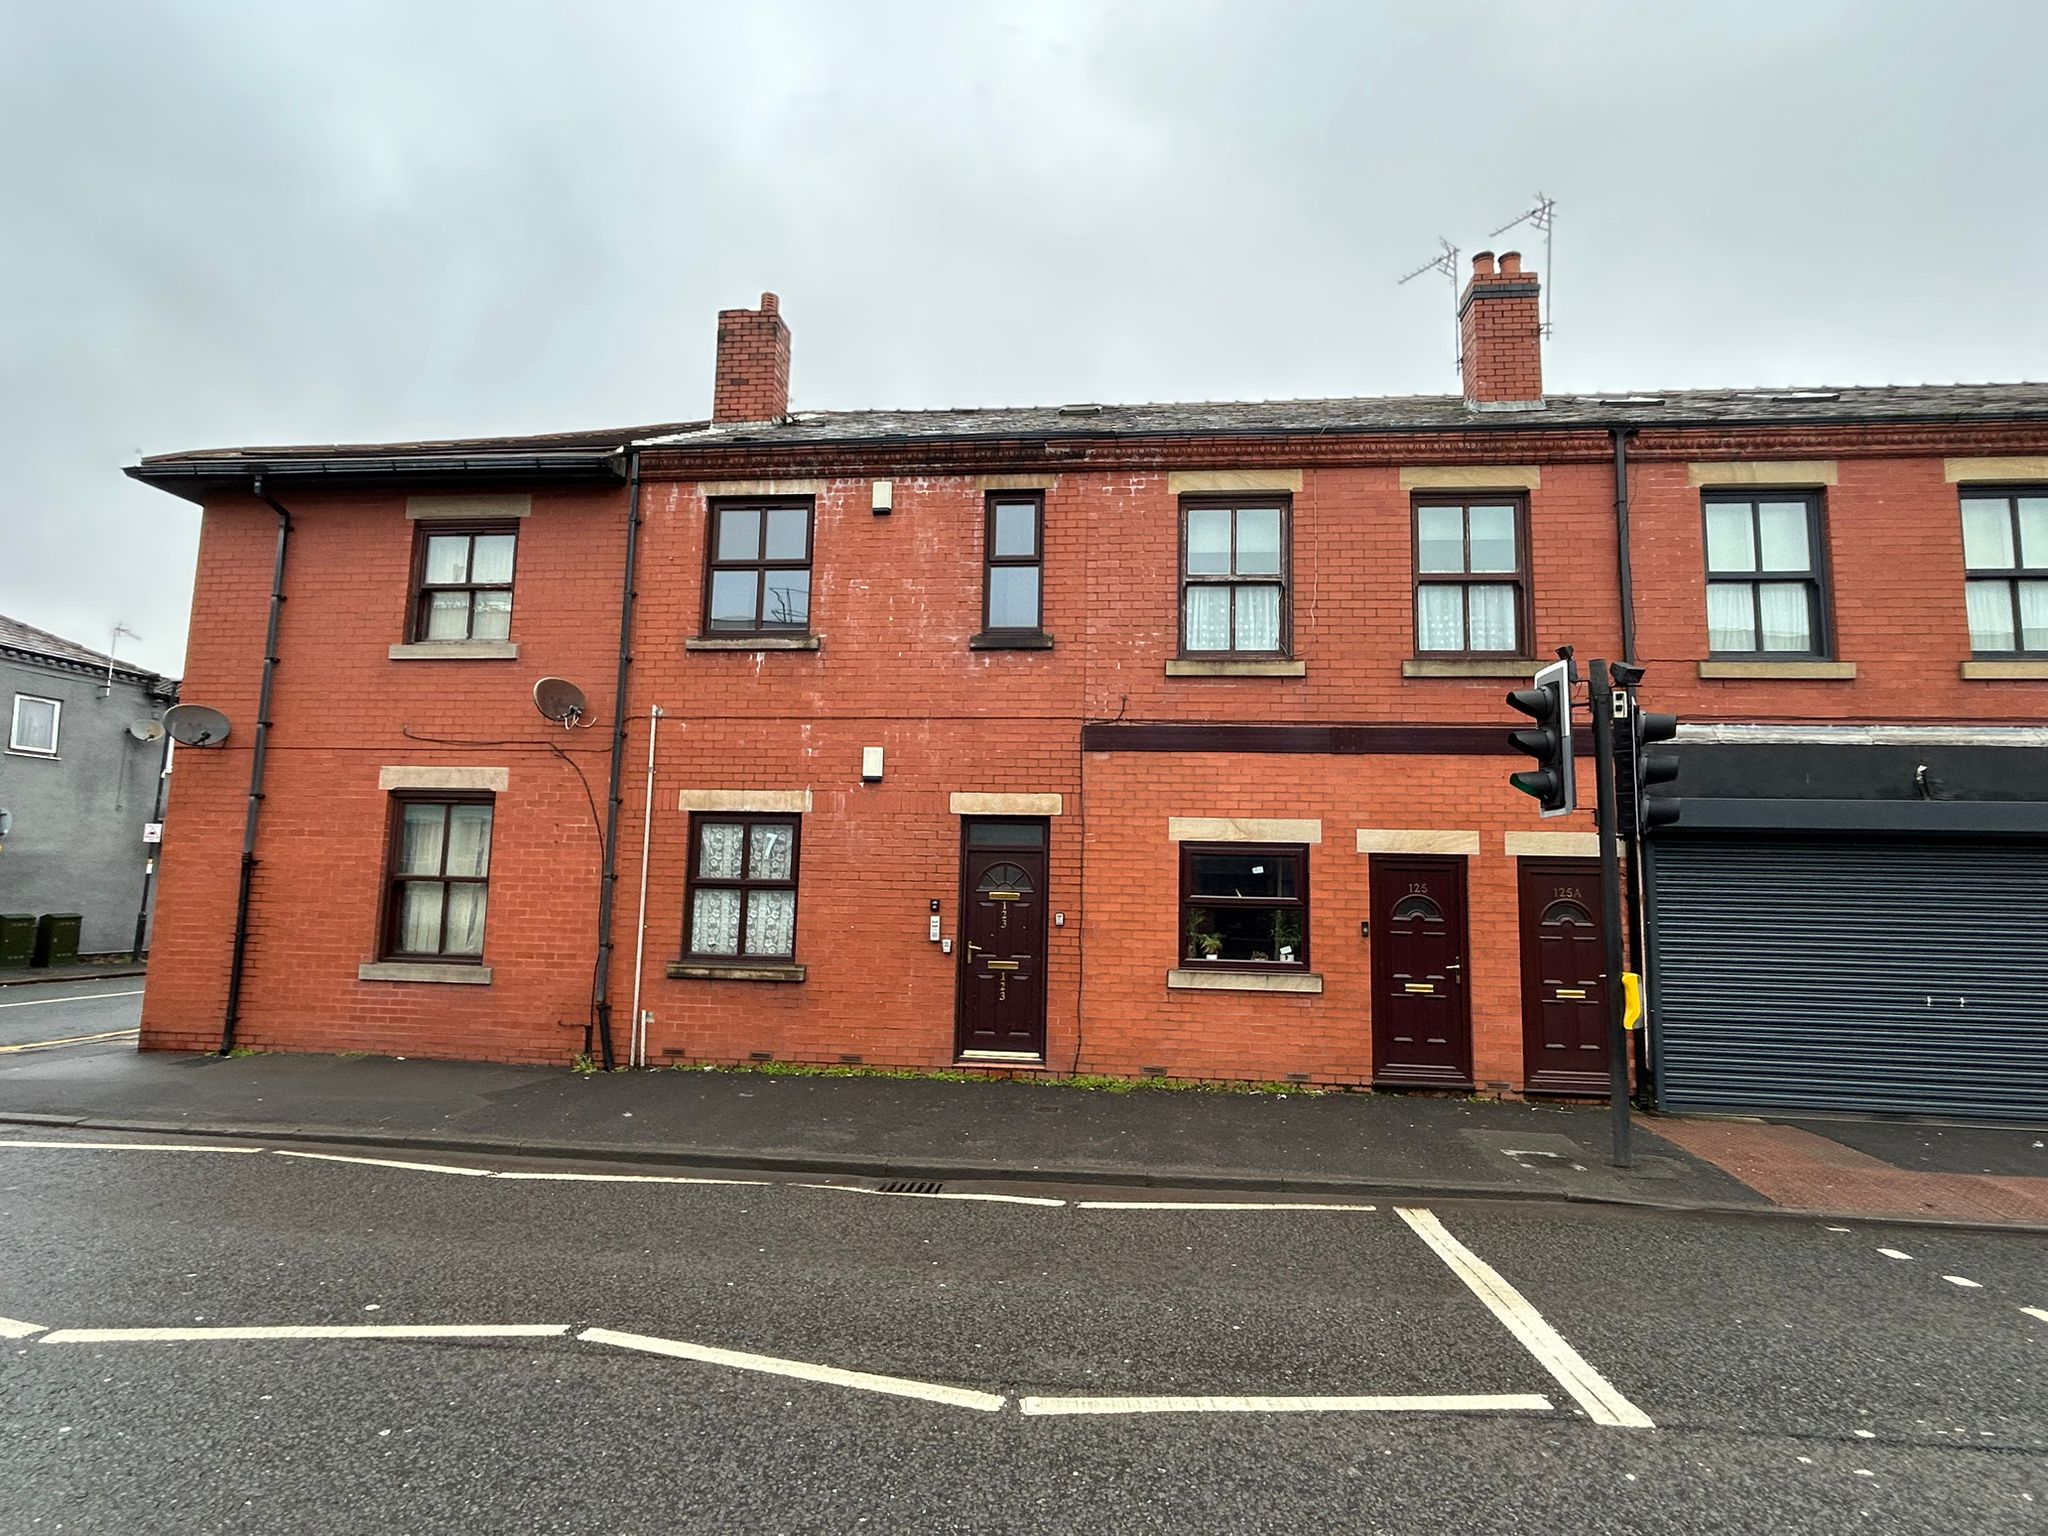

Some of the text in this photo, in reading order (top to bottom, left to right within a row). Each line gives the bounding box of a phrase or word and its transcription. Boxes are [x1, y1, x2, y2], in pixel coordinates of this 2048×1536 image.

[763, 832, 778, 859] 7
[1409, 883, 1427, 893] 125
[1554, 887, 1582, 898] 125A
